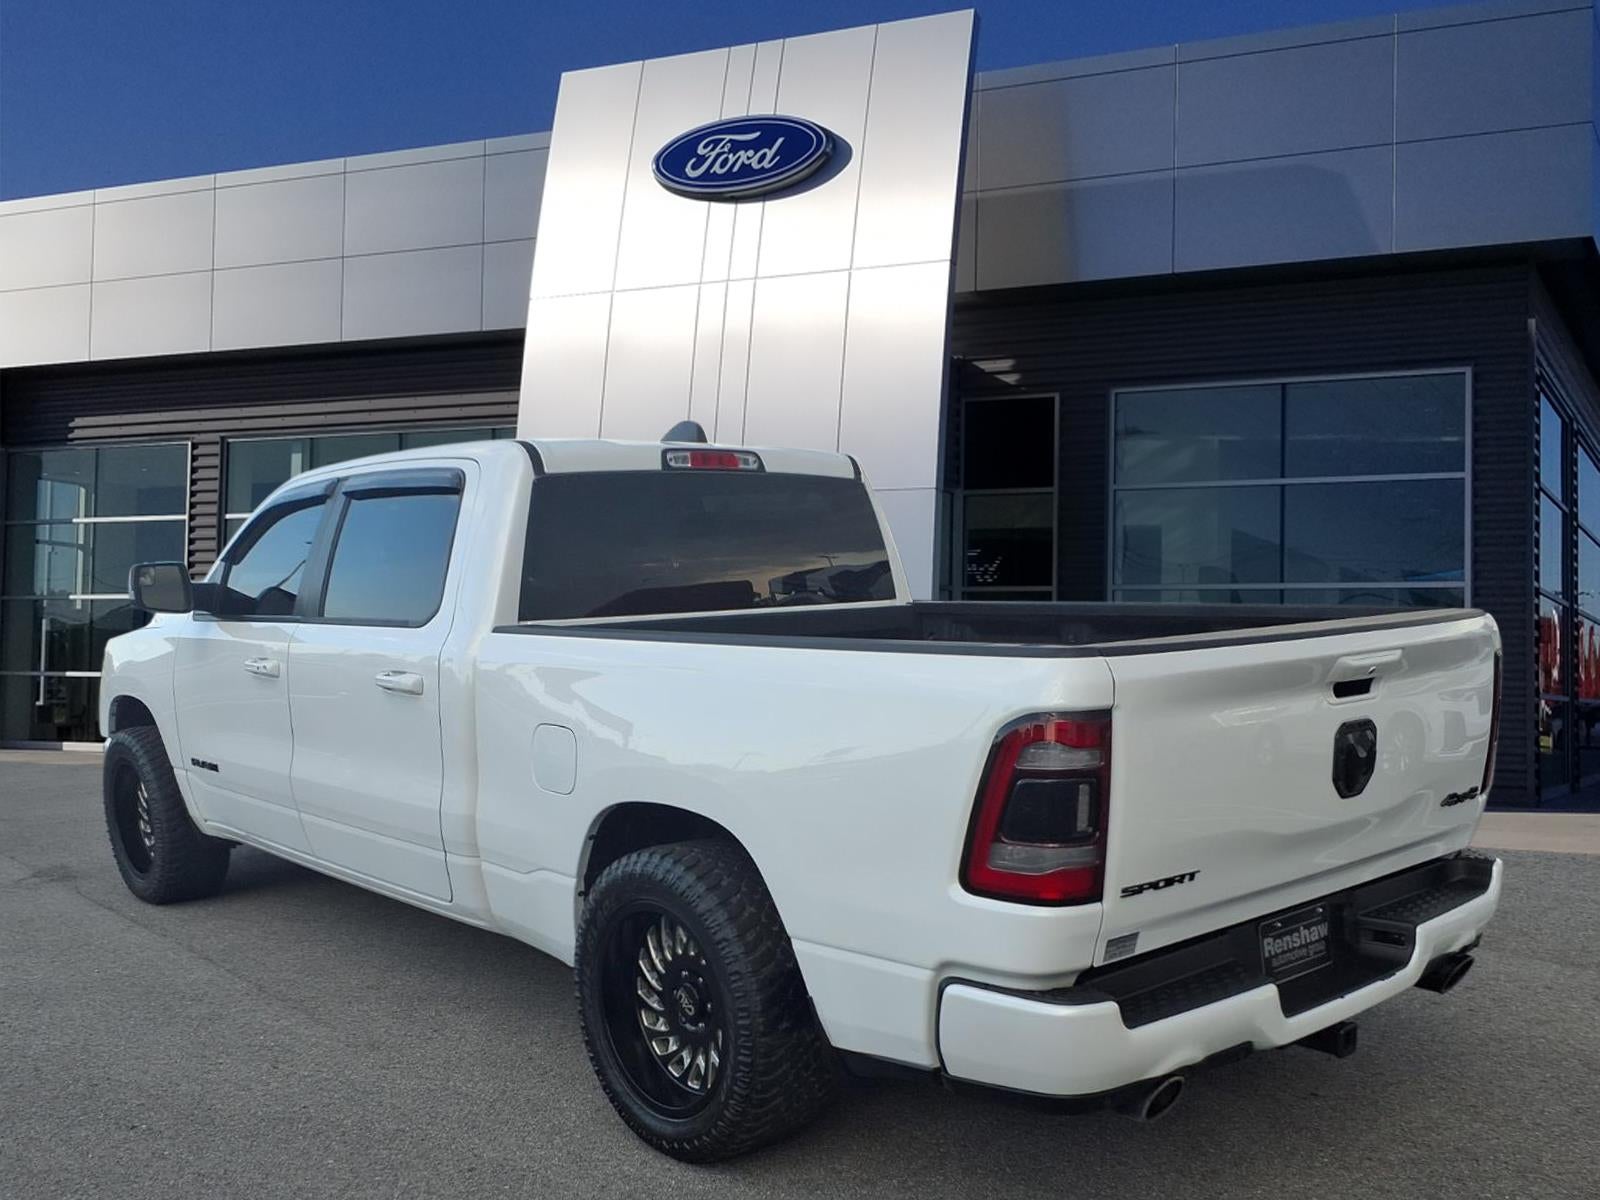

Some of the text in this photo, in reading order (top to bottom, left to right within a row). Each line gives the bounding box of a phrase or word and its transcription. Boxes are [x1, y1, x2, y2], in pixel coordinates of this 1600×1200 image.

[685, 131, 785, 178] Ford
[1120, 870, 1201, 898] SPORT
[1263, 922, 1328, 958] Renshaw
